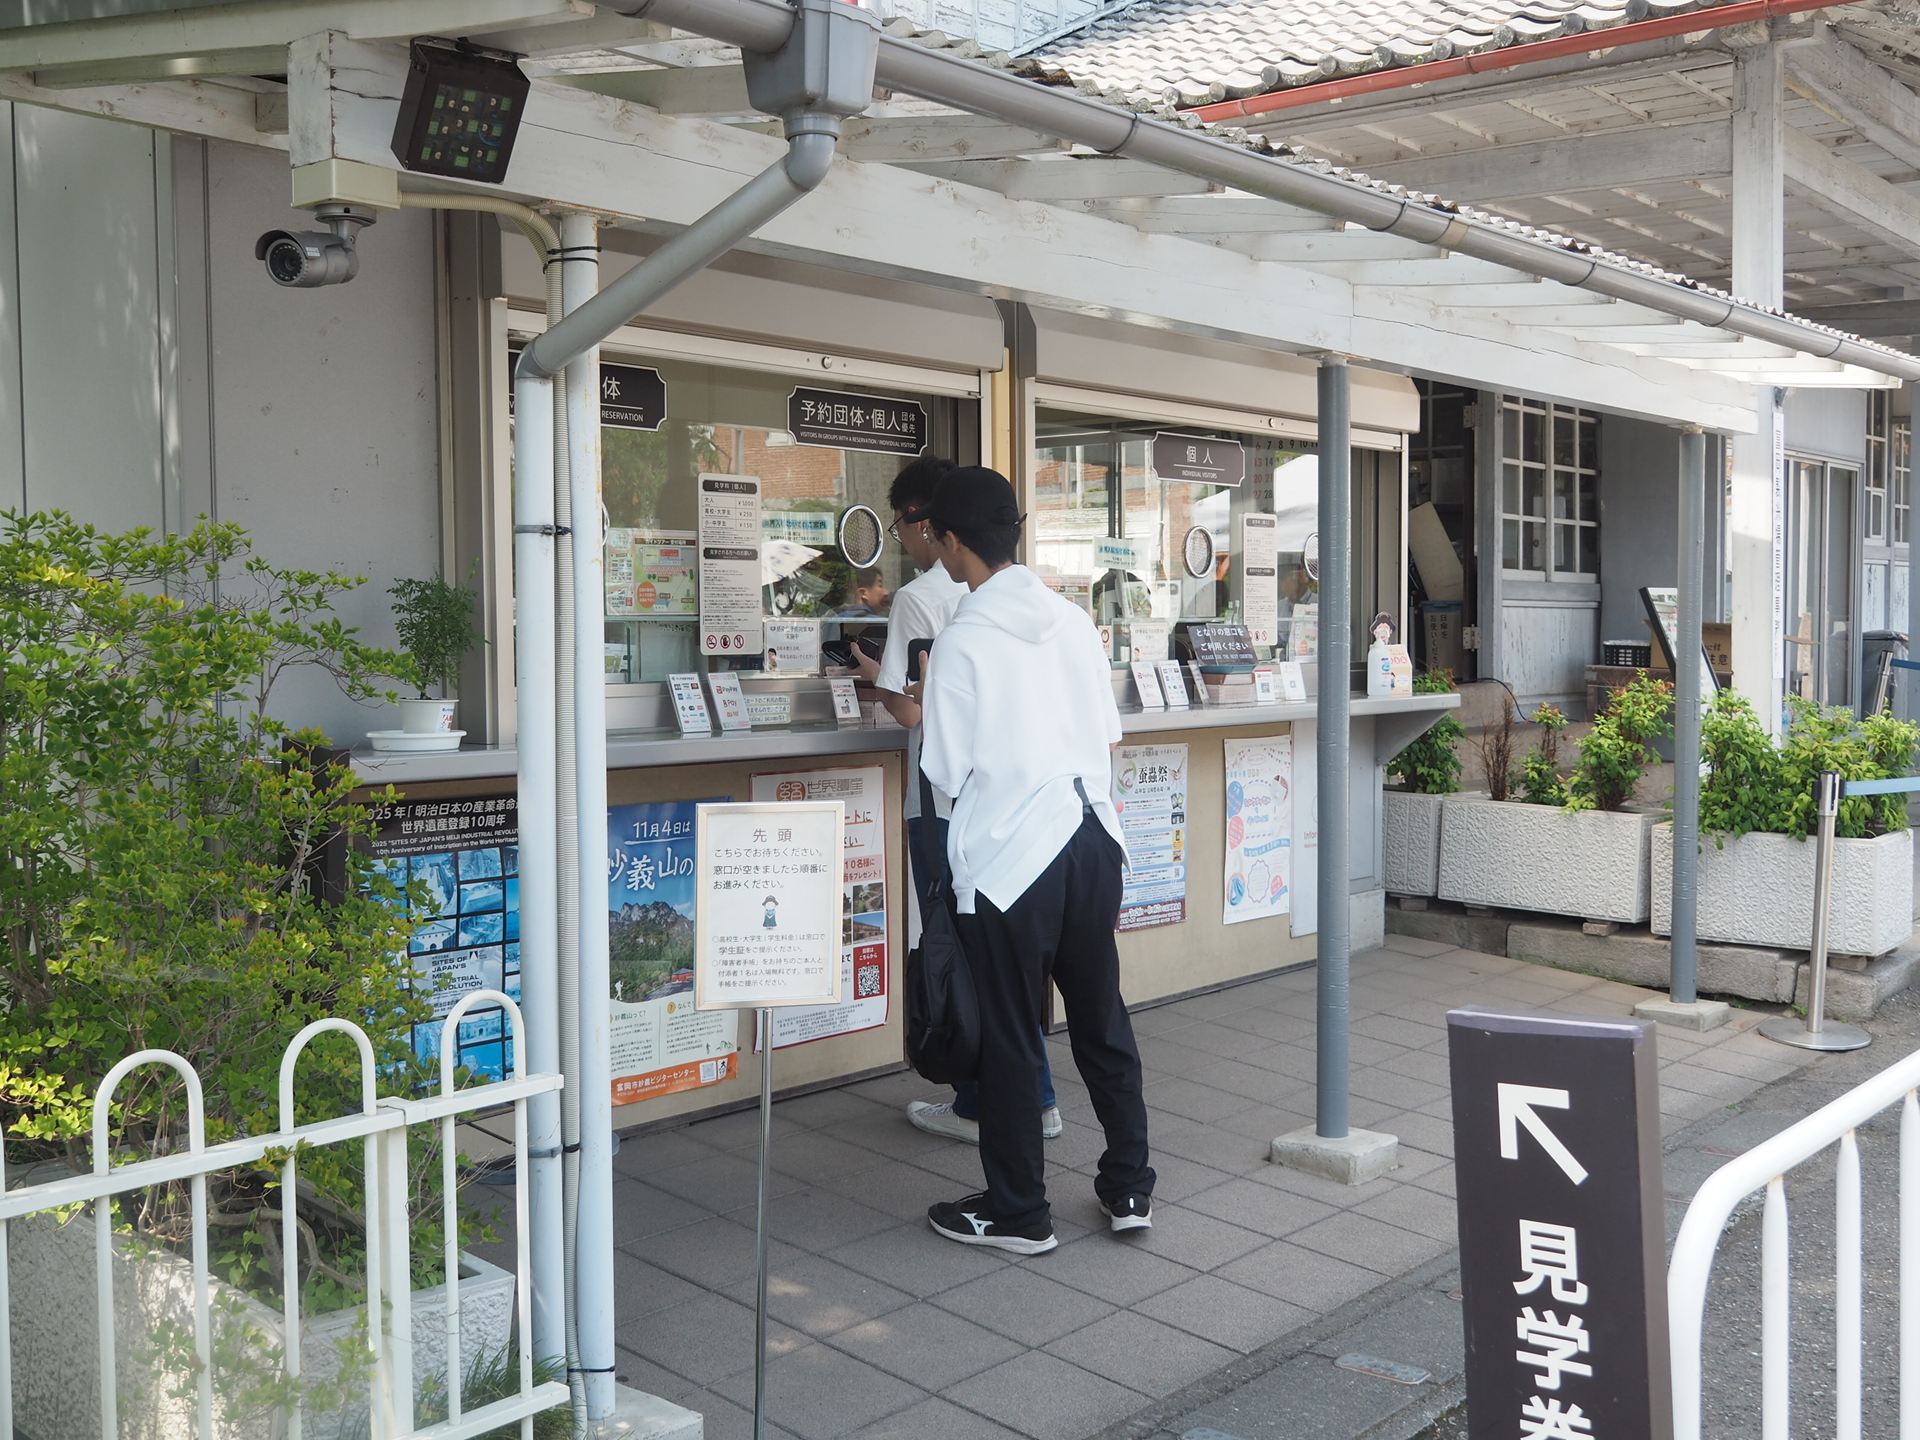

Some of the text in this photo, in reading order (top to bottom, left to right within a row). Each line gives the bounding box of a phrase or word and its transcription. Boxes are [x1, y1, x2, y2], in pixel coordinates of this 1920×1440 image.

[601, 410, 644, 422] RESERVATION
[800, 399, 901, 432] 予約団体・個人
[901, 411, 916, 422] 団体
[800, 431, 818, 439] VISITORS
[852, 437, 877, 445] RESERVATION
[879, 439, 900, 448] INDIVIDUAL
[900, 441, 917, 449] VISITORS
[1267, 441, 1272, 449] 7
[1278, 440, 1284, 449] 8
[1290, 440, 1295, 448] 9
[1186, 445, 1213, 465] 個人
[1265, 457, 1273, 467] 14
[1264, 489, 1273, 499] 28
[1196, 627, 1244, 637] となりの窓口を
[1200, 642, 1249, 651] ご利用ください
[401, 813, 507, 834] 世界遺産登録10周年
[633, 819, 691, 838] 11月4日は
[410, 837, 418, 845] OF
[419, 836, 446, 845] JAPAN'S
[446, 834, 461, 842] MEIJI
[461, 831, 493, 840] INDUSTRIAL
[390, 845, 425, 855] Anniversary
[434, 842, 462, 851] Inscription
[480, 838, 494, 846] World
[495, 837, 518, 845] Heritage
[714, 848, 823, 858] こちらでお待ちください。
[713, 864, 828, 875] 窓口が空きましたら順番に
[713, 880, 785, 890] お進みください。
[431, 957, 455, 967] SITES
[431, 963, 467, 973] JAPAN'S
[616, 1068, 696, 1092] 富岡市妙義ビジターセンター
